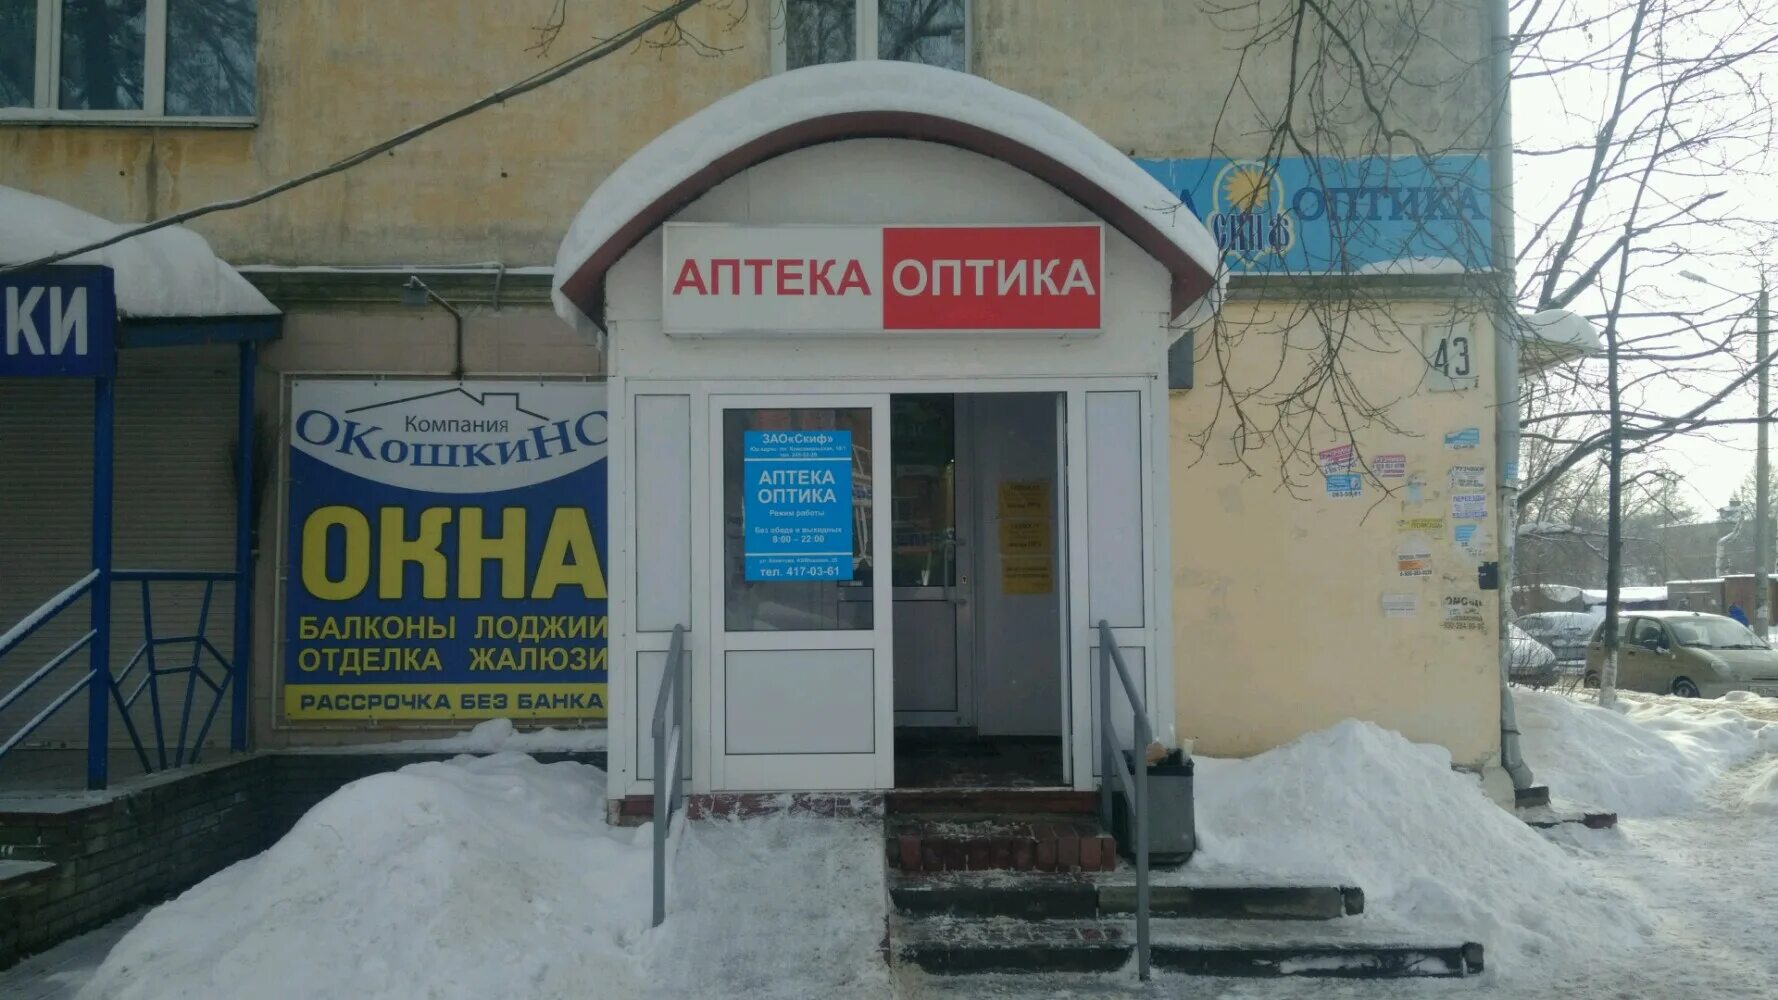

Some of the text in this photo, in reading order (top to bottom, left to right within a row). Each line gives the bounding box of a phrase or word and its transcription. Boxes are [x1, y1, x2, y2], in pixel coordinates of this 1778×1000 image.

[1292, 186, 1486, 222] ОПТИКА
[672, 258, 1096, 297] АПТЕКА ОПТИКА
[1434, 337, 1470, 376] 43
[405, 415, 509, 433] Компания
[759, 470, 836, 486] АПТЕКА
[758, 488, 837, 504] ОПТИКА
[769, 508, 825, 519] Режим работы
[755, 526, 769, 534] Без
[770, 526, 794, 536] обеда
[802, 527, 842, 536] выходных
[301, 505, 607, 601] ОКНА
[760, 566, 839, 577] тел. 417-03-61
[299, 616, 608, 643] БАЛКОНЫ ЛОДЖИИ
[298, 648, 608, 675] ОТДЕЛКА ЖАЛЮЗИ
[300, 693, 604, 711] РАССРОЧКА БЕЗ БАНКА
